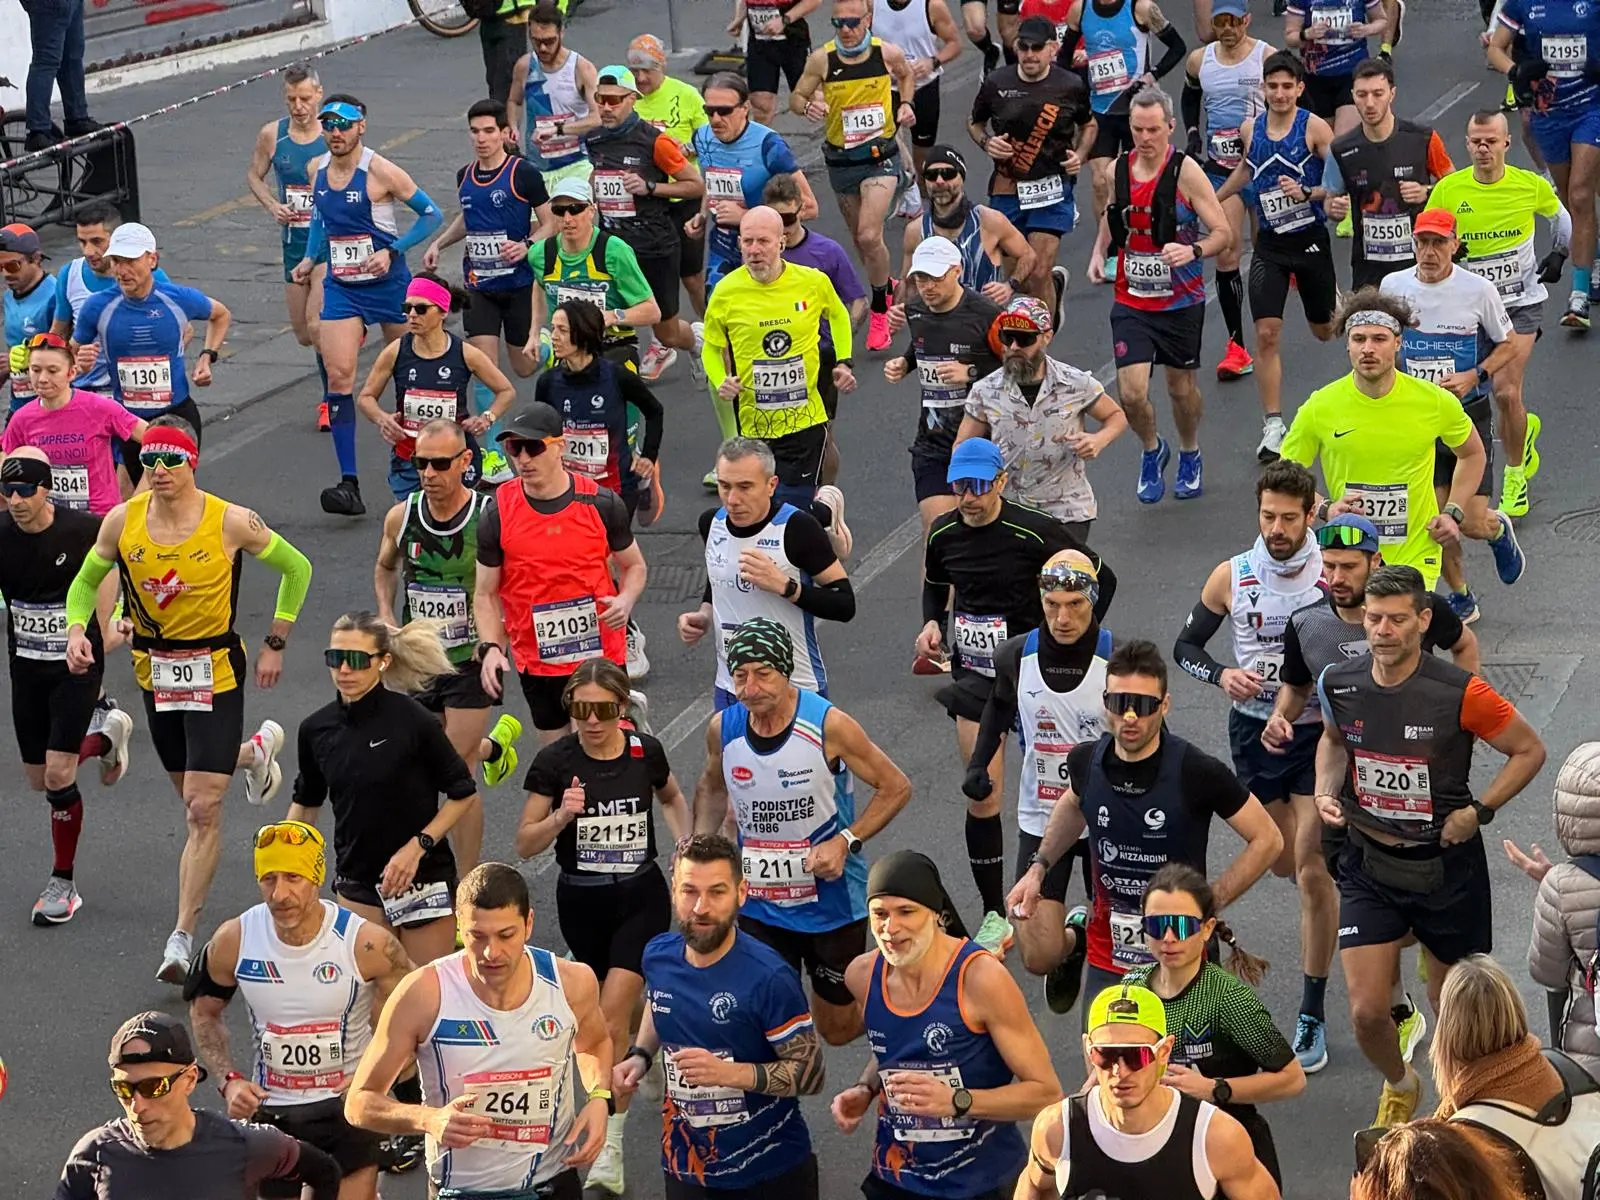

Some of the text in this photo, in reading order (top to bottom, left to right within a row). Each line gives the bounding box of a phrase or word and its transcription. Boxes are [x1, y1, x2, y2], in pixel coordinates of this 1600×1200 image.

[1550, 45, 1579, 58] 2195
[1098, 63, 1115, 77] 851
[854, 114, 874, 128] 143
[1015, 102, 1060, 173] VALENCIA
[602, 182, 622, 196] 302
[715, 180, 734, 194] 170
[1026, 182, 1053, 196] 2361
[1371, 224, 1402, 238] 2550
[345, 247, 358, 261] 97
[1131, 261, 1161, 277] 2568
[759, 318, 792, 328] BRESCIA
[132, 369, 157, 385] 130
[763, 368, 797, 387] 2719
[417, 404, 443, 418] 659
[570, 441, 593, 456] 201
[757, 538, 780, 547] AVIS
[419, 601, 456, 618] 4284
[21, 617, 58, 633] 2236
[547, 615, 589, 638] 2103
[963, 628, 995, 649] 2431
[542, 647, 558, 655] 21K
[172, 665, 193, 682] 90
[1375, 769, 1410, 790] 220
[752, 796, 814, 811] PODISTICA
[752, 807, 814, 822] EMPOLESE
[590, 823, 636, 842] 2115
[753, 823, 779, 833] 1986
[580, 851, 596, 859] 21K
[759, 858, 792, 878] 211
[748, 888, 764, 897] 42K
[281, 1044, 321, 1066] 208
[485, 1092, 529, 1115] 264
[896, 1116, 913, 1124] 21K
